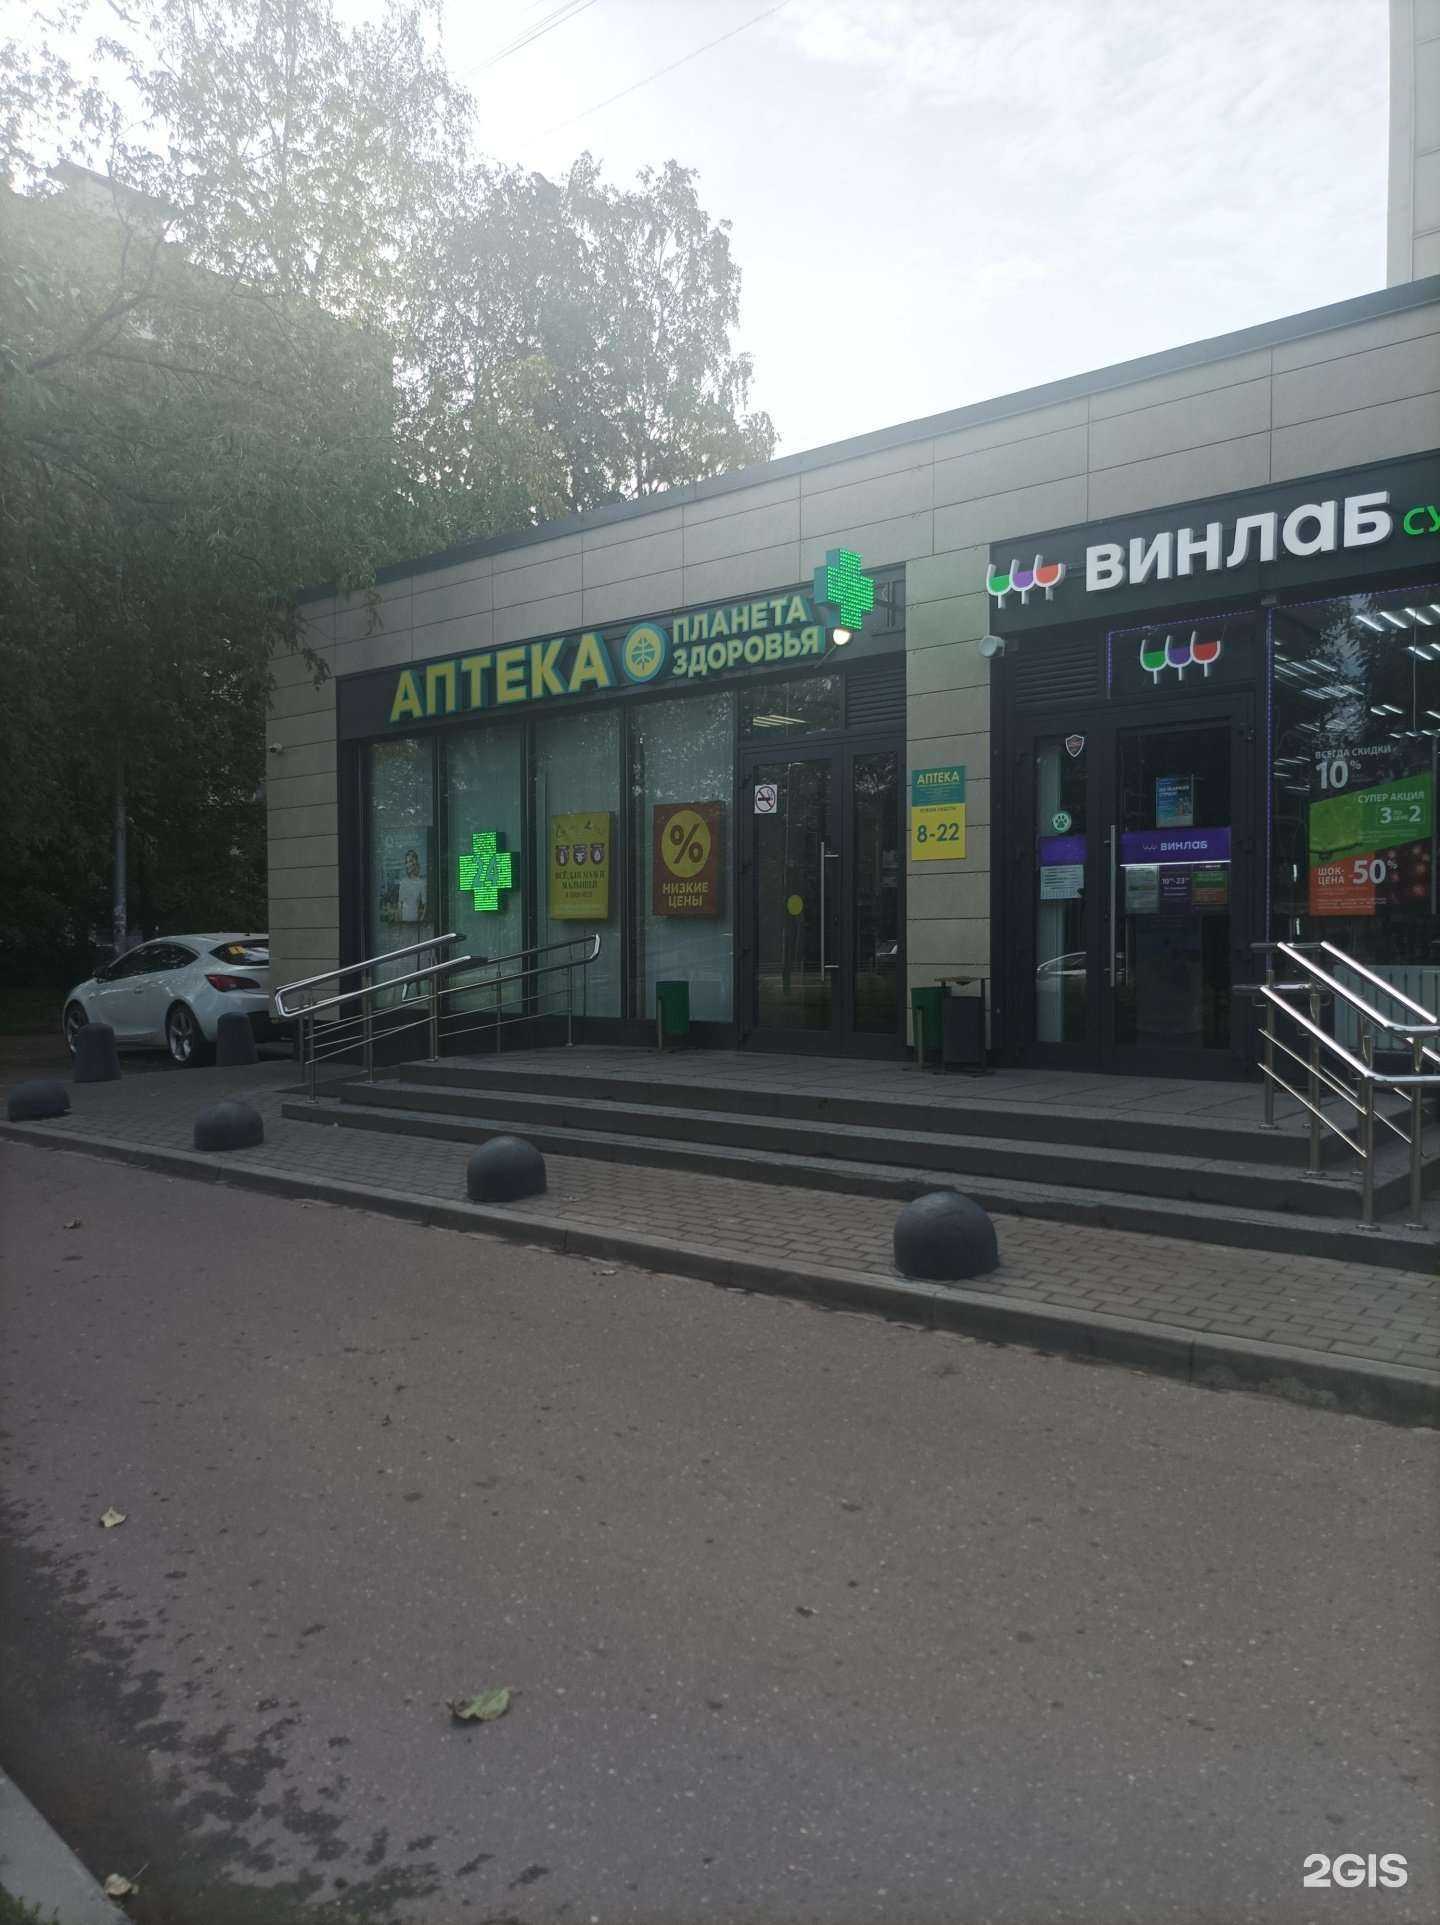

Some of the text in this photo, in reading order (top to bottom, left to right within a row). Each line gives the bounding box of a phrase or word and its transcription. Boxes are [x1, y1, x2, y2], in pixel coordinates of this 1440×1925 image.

[671, 595, 808, 645] ПЛАНЕТА
[671, 625, 821, 678] ЗДОРОВЬЯ
[389, 632, 615, 723] АПТЕКА
[1351, 745, 1391, 758] СКИДКИ
[917, 770, 960, 785] АПТЕКА
[1358, 791, 1425, 804] СУПЕР АКЦИЯ
[1380, 807, 1392, 824] 3
[1409, 805, 1421, 822] 2
[916, 822, 960, 844] 8-22
[662, 881, 709, 896] НИЗКИЕ
[1318, 876, 1344, 886] ЦЕНА
[668, 895, 703, 909] ЦЕНЫ
